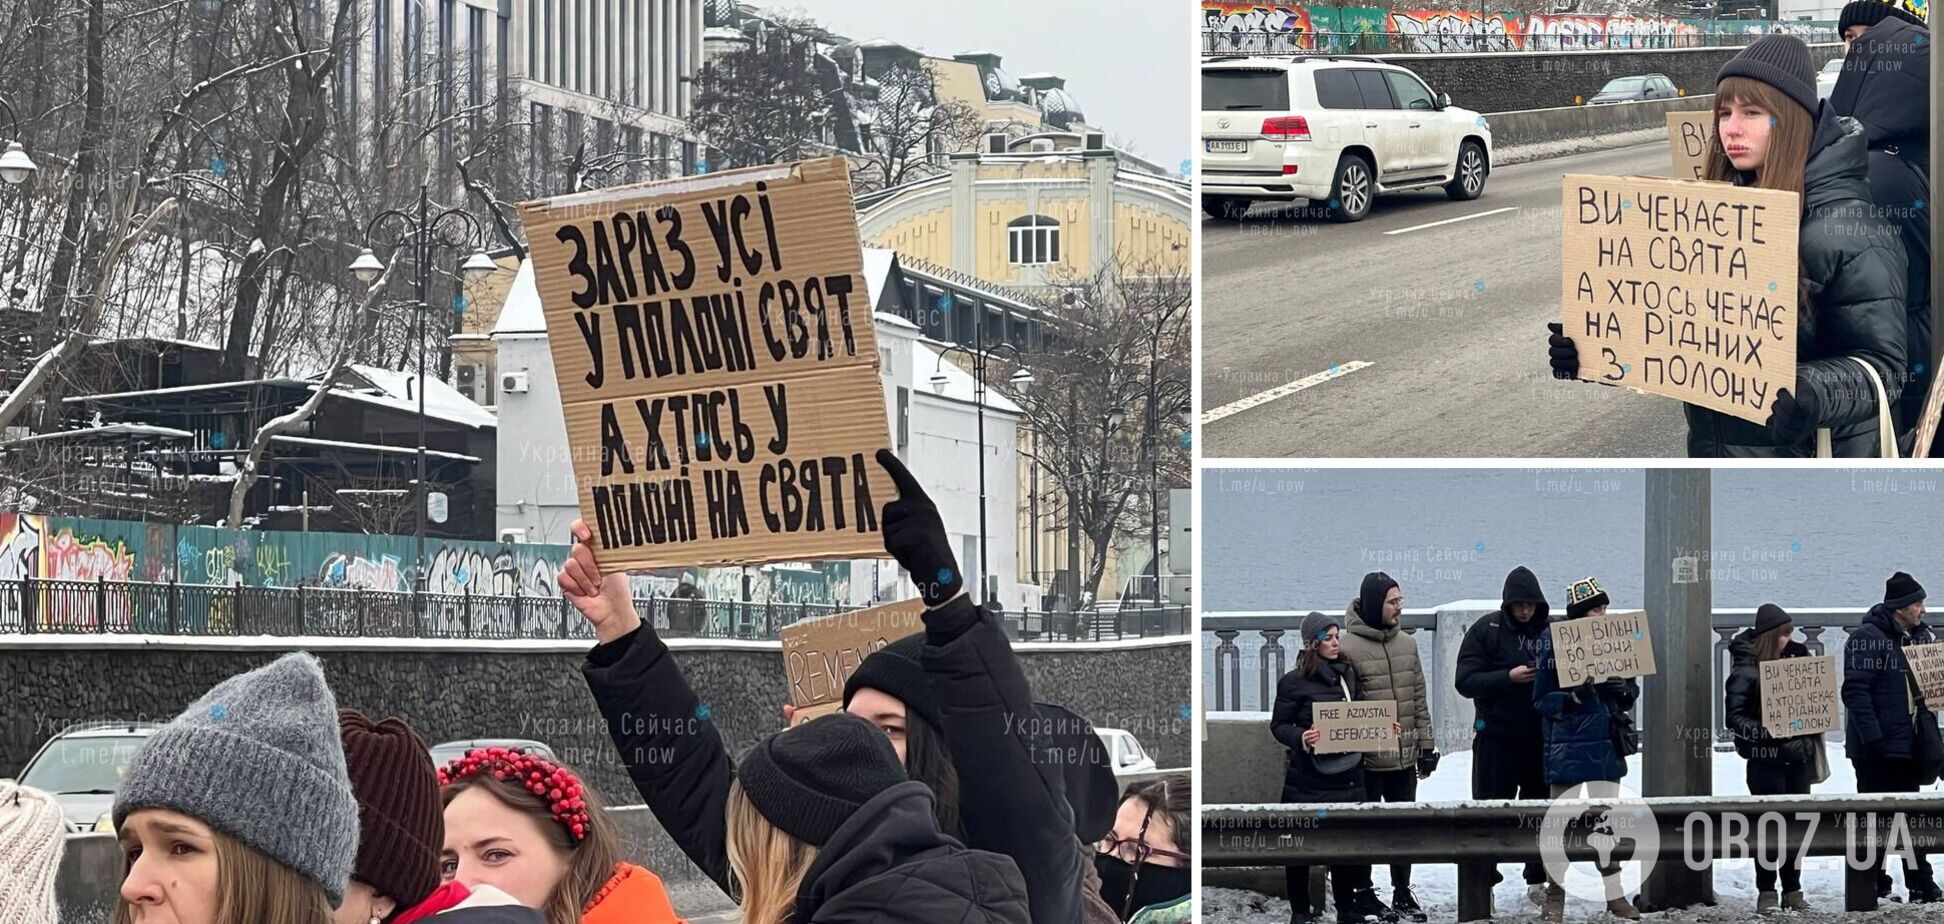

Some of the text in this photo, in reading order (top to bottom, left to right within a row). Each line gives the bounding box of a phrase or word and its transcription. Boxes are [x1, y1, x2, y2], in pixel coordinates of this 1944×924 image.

[1579, 187, 1766, 244] ВИ ЧЕКАЄТЕ
[555, 181, 782, 309] ЗАРАЗ УСІ
[1598, 236, 1748, 280] НА СВЯТА
[1578, 271, 1786, 341] А ХТОСЬ ЧЕКАЄ
[574, 274, 856, 388] У ПОЛОНІ СВЯТ
[1585, 311, 1762, 370] НА РІДНИХ
[1602, 347, 1768, 409] З ПОЛОНУ
[601, 383, 789, 476] А ХТОСЬ У
[592, 453, 878, 550] ПОЛОНІ НА СВЯТА
[1558, 625, 1582, 645] ВИ
[1591, 616, 1639, 640] ВІЛЬНІ
[1566, 646, 1585, 663] БО
[1592, 640, 1632, 656] ВОНИ
[1568, 654, 1639, 682] В ПОЛОНІ
[1765, 665, 1780, 680] ВИ
[1772, 681, 1784, 695] НА
[1320, 707, 1391, 720] FREE AZOVSTAL
[1766, 697, 1773, 709] А
[1769, 710, 1782, 722] НА
[1329, 727, 1388, 741] DEFENDERS
[1789, 716, 1831, 733] ПОЛОНУ
